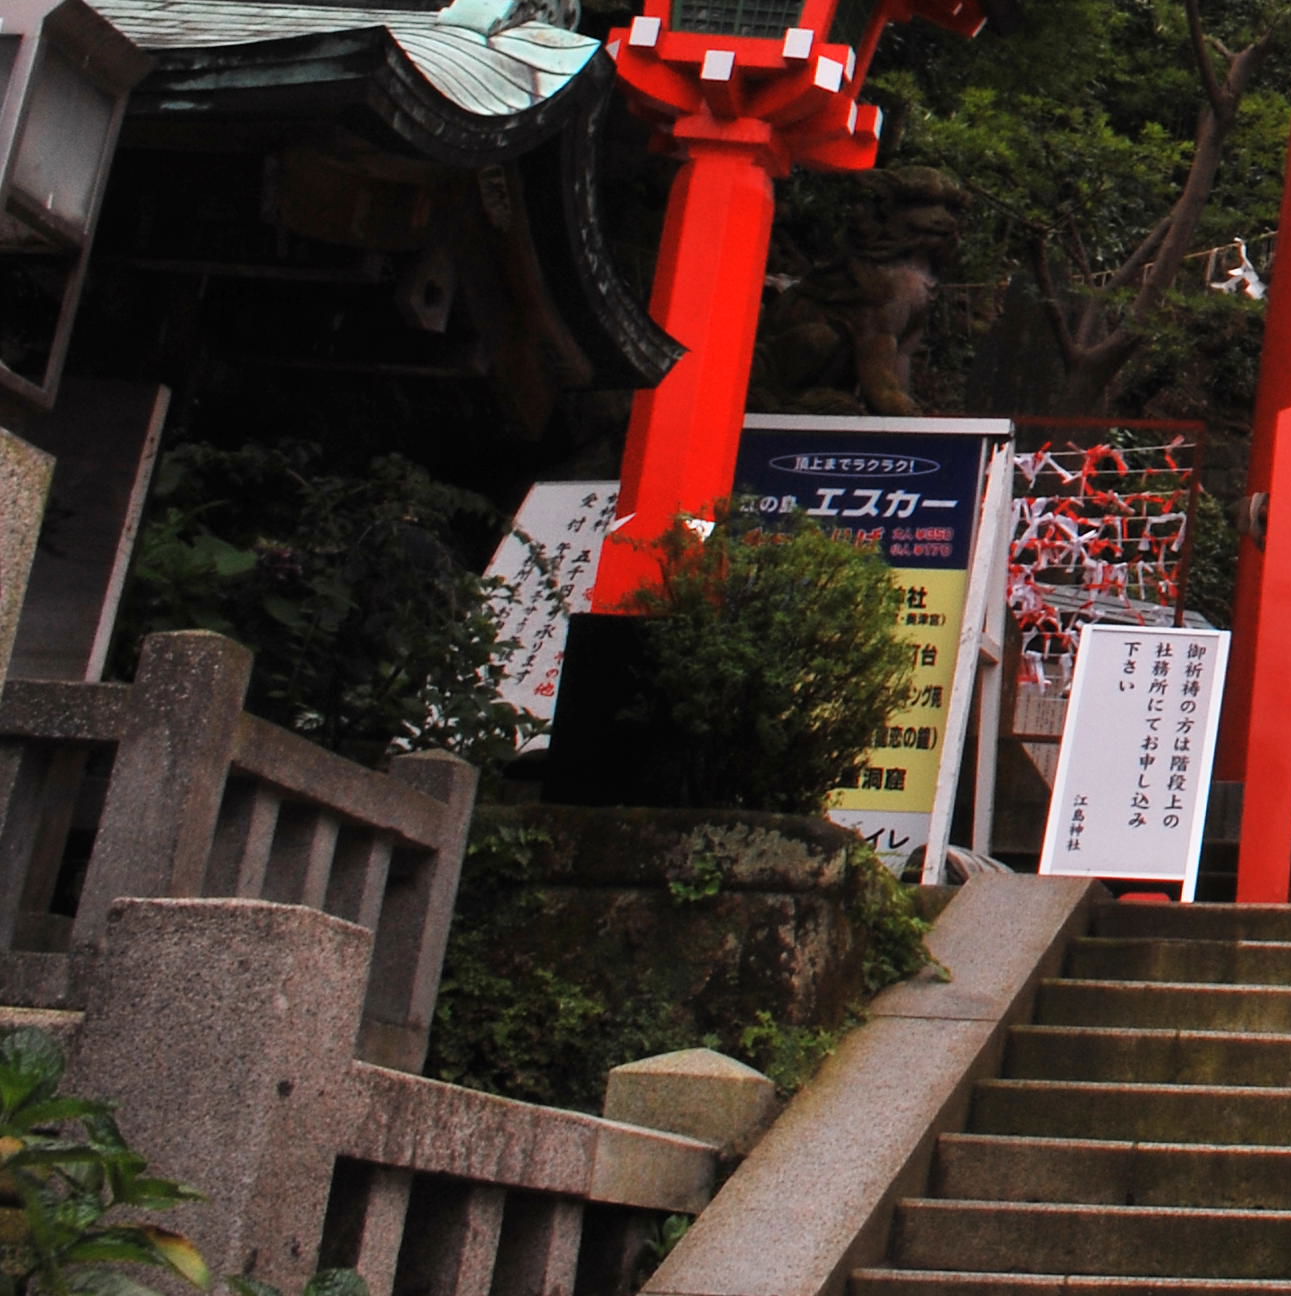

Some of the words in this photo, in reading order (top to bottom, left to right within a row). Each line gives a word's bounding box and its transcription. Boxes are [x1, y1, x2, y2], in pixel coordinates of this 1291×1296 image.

[807, 487, 959, 519] エスカー
[1118, 641, 1143, 693] 下さい
[1127, 642, 1174, 829] 社務所にてお申し込み
[1162, 642, 1207, 829] 御祈祷の方は階段上の
[1066, 794, 1089, 853] 江島神社
